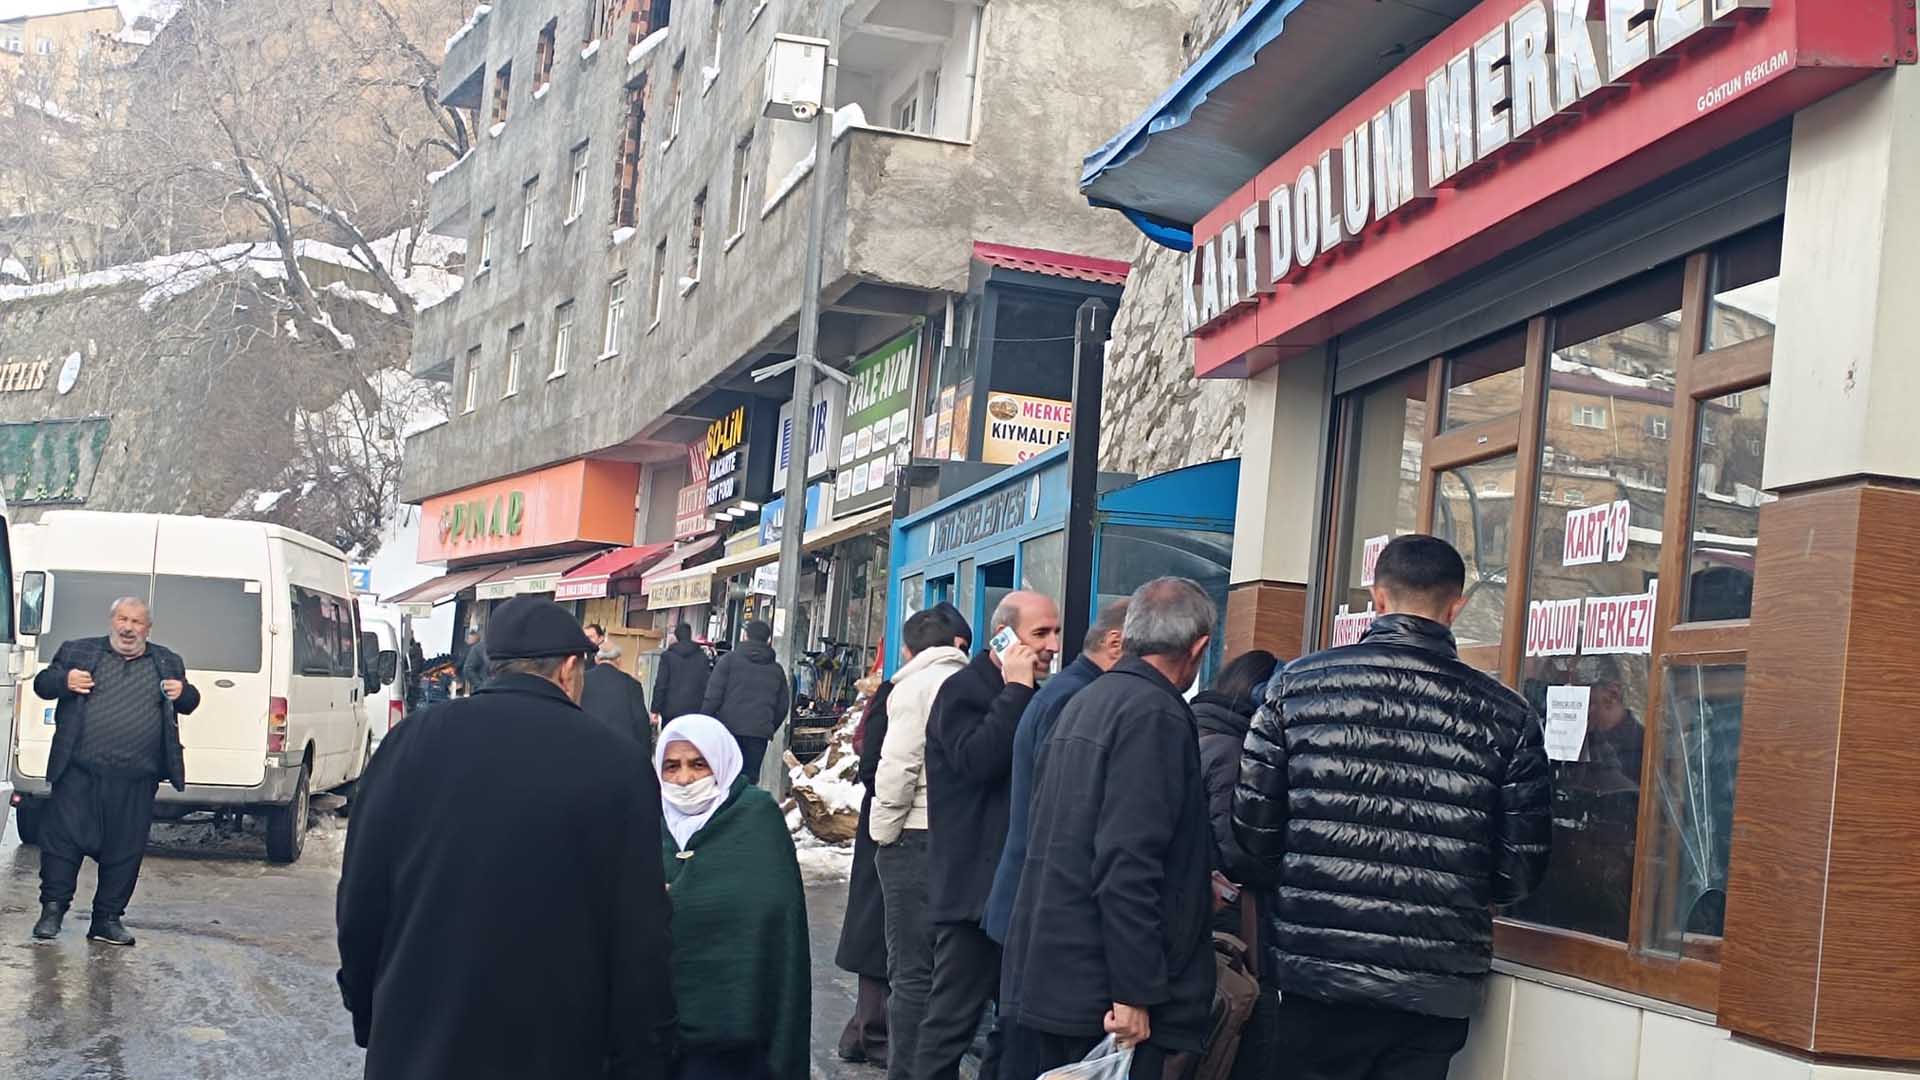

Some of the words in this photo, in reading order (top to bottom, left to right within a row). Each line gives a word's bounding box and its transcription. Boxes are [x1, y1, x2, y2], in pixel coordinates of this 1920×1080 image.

[1744, 49, 1788, 87] REKLAM
[1182, 200, 1260, 336] KART
[1269, 90, 1414, 284] DOLUM
[1425, 0, 1738, 188] MERKE
[0, 356, 48, 391] İTLİS
[879, 344, 913, 401] AVM
[992, 422, 1052, 445] KIYMALI
[720, 477, 734, 501] FOOD
[451, 490, 524, 544] PINAR
[1566, 510, 1606, 560] KART
[1610, 505, 1627, 554] 13
[1528, 604, 1578, 650] DOLUM
[1584, 586, 1654, 648] MERKEZİ
